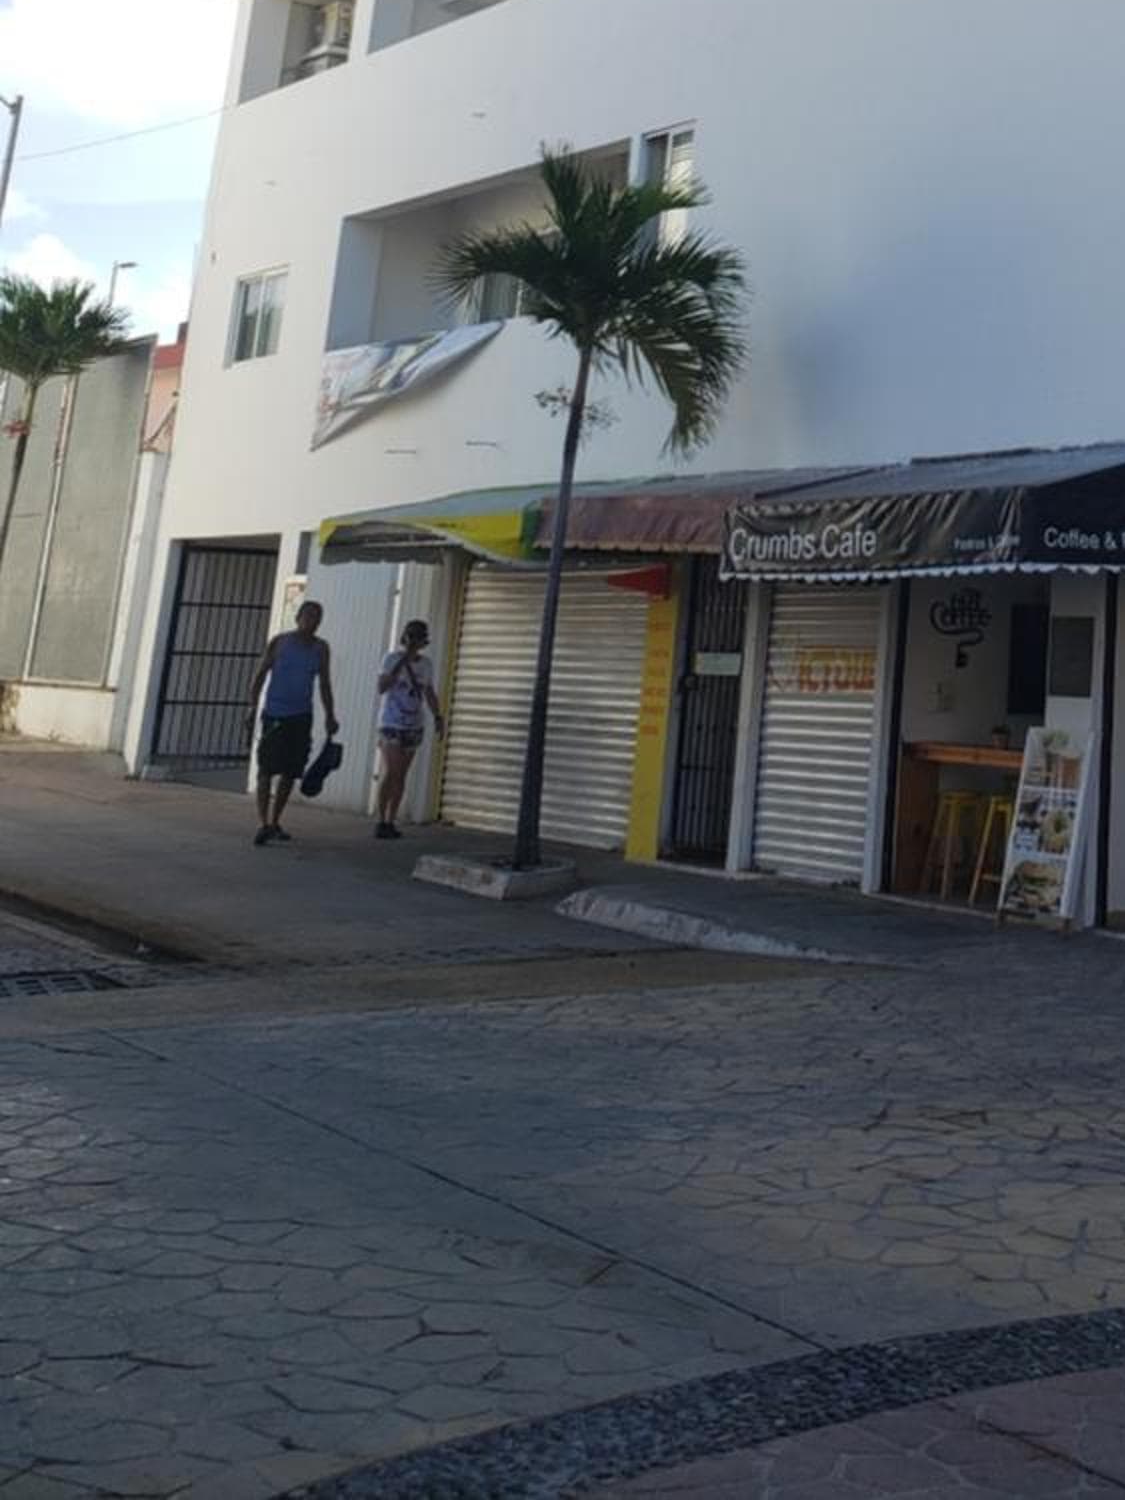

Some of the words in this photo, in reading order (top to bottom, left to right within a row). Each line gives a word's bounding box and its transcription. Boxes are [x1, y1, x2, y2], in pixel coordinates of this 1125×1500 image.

[729, 525, 817, 561] Crumbs
[821, 523, 877, 558] Cafe
[1043, 526, 1100, 549] Coffee
[1103, 531, 1117, 549] &
